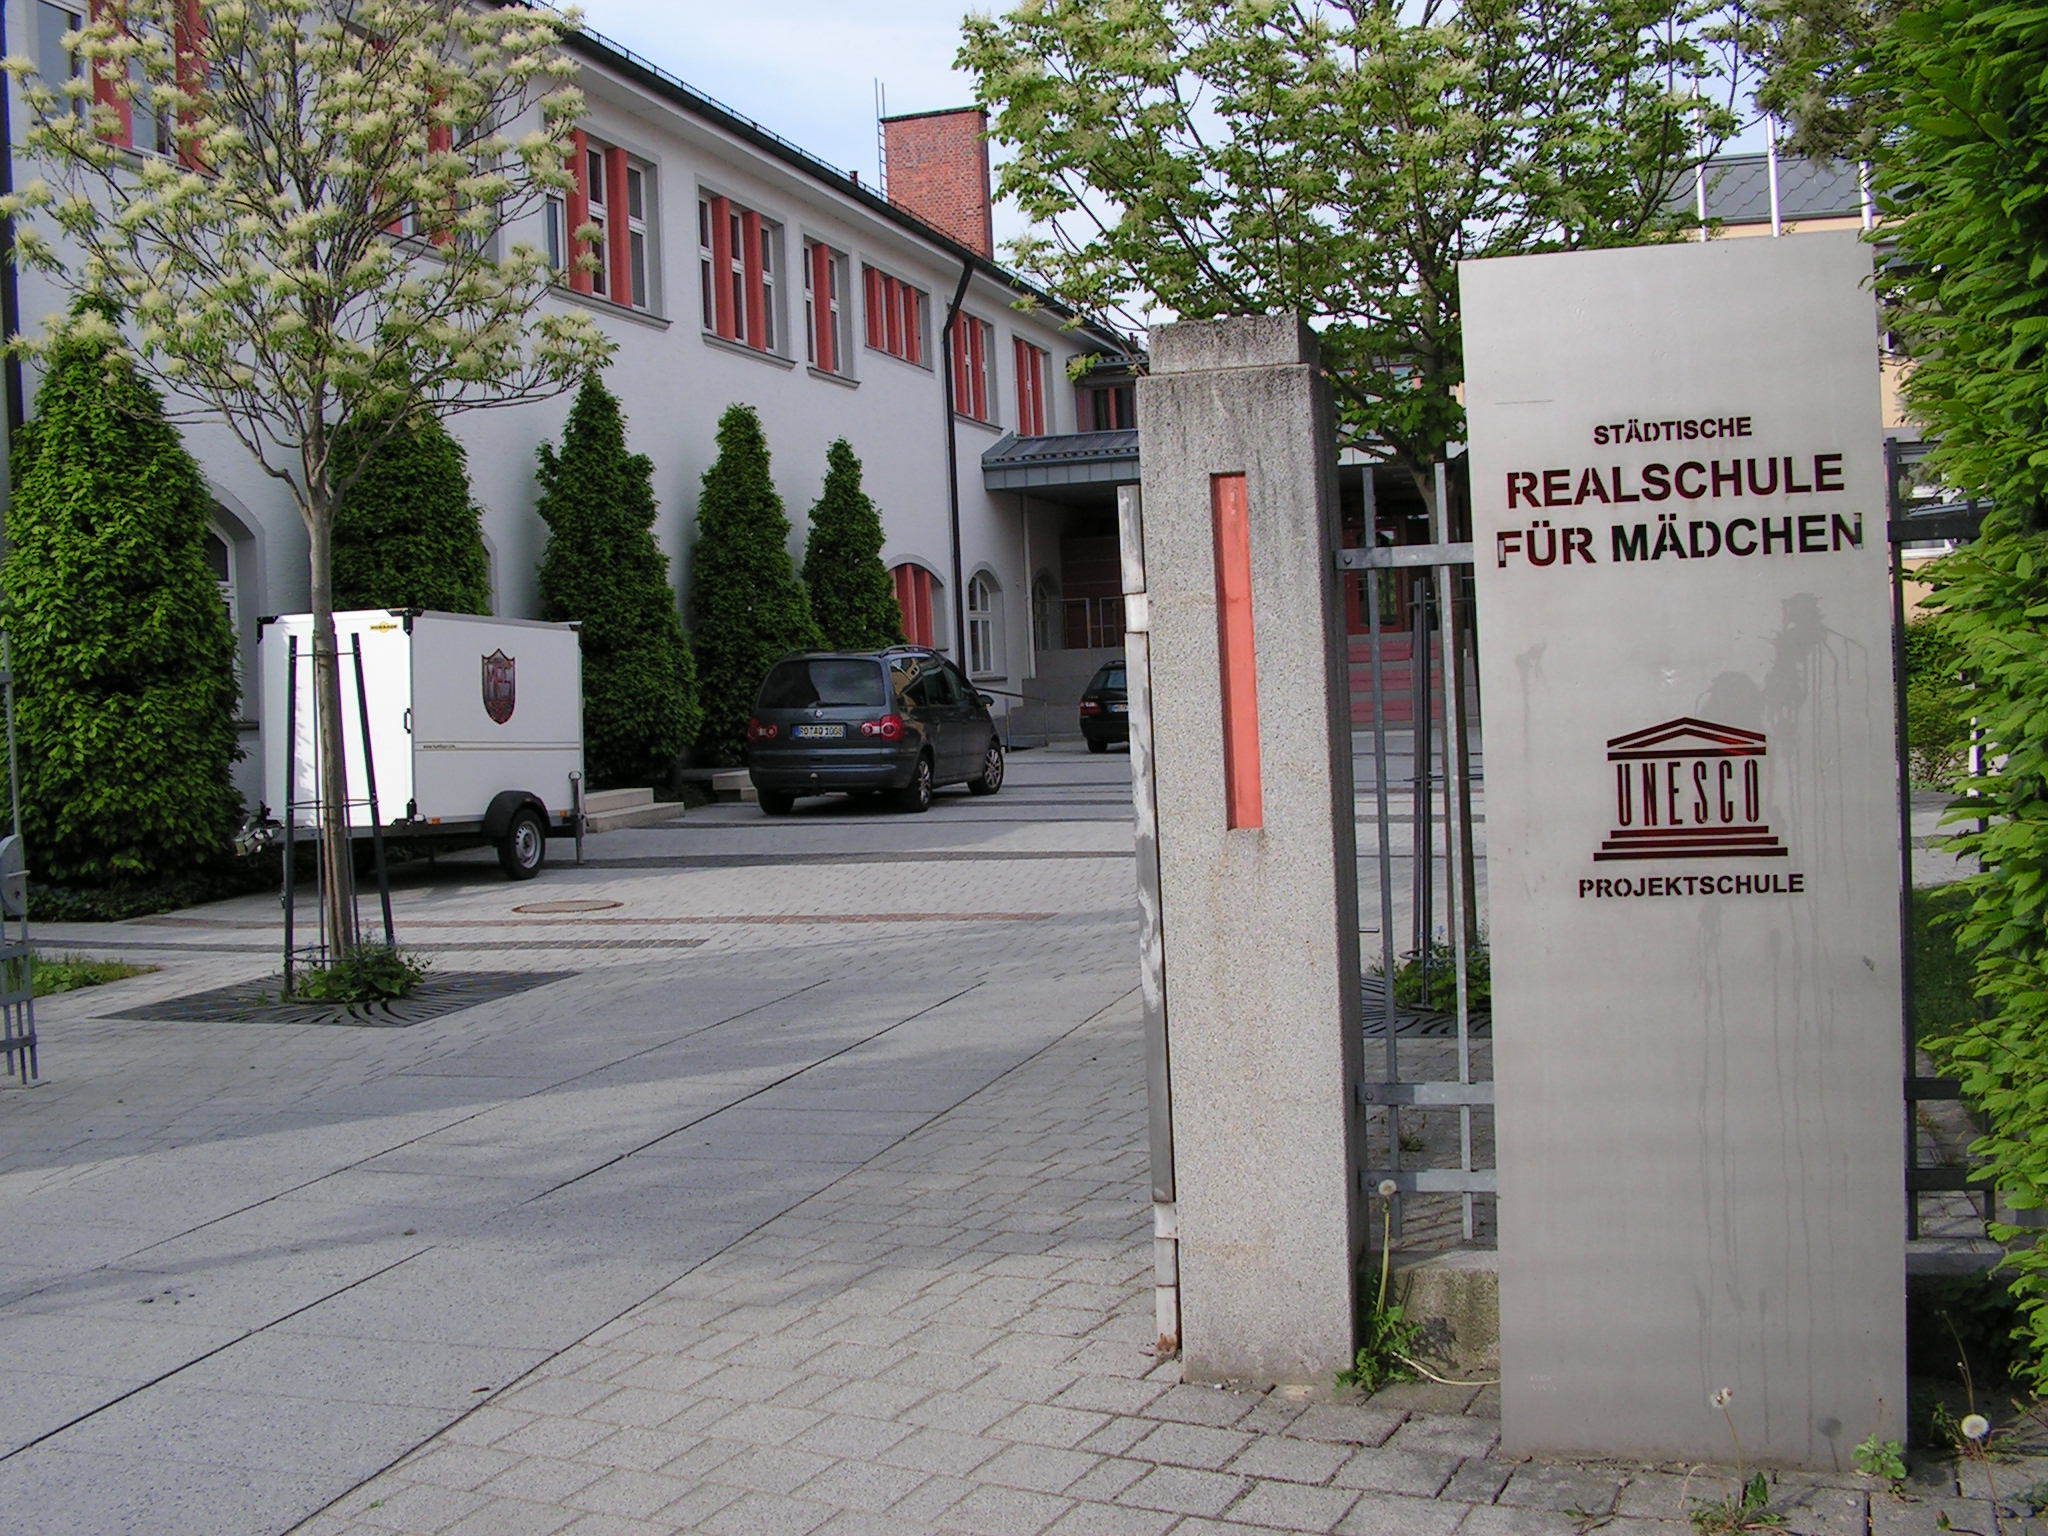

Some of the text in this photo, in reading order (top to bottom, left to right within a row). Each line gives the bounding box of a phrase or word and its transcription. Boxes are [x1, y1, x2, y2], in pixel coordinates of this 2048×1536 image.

[1592, 416, 1752, 445] STÄDTISCHE
[1506, 453, 1845, 509] REALSCHULE
[1497, 512, 1864, 568] FÜR MÄDCHEN
[1617, 759, 1760, 826] UNESCO
[1578, 873, 1804, 898] PROJEKTSCHULE
